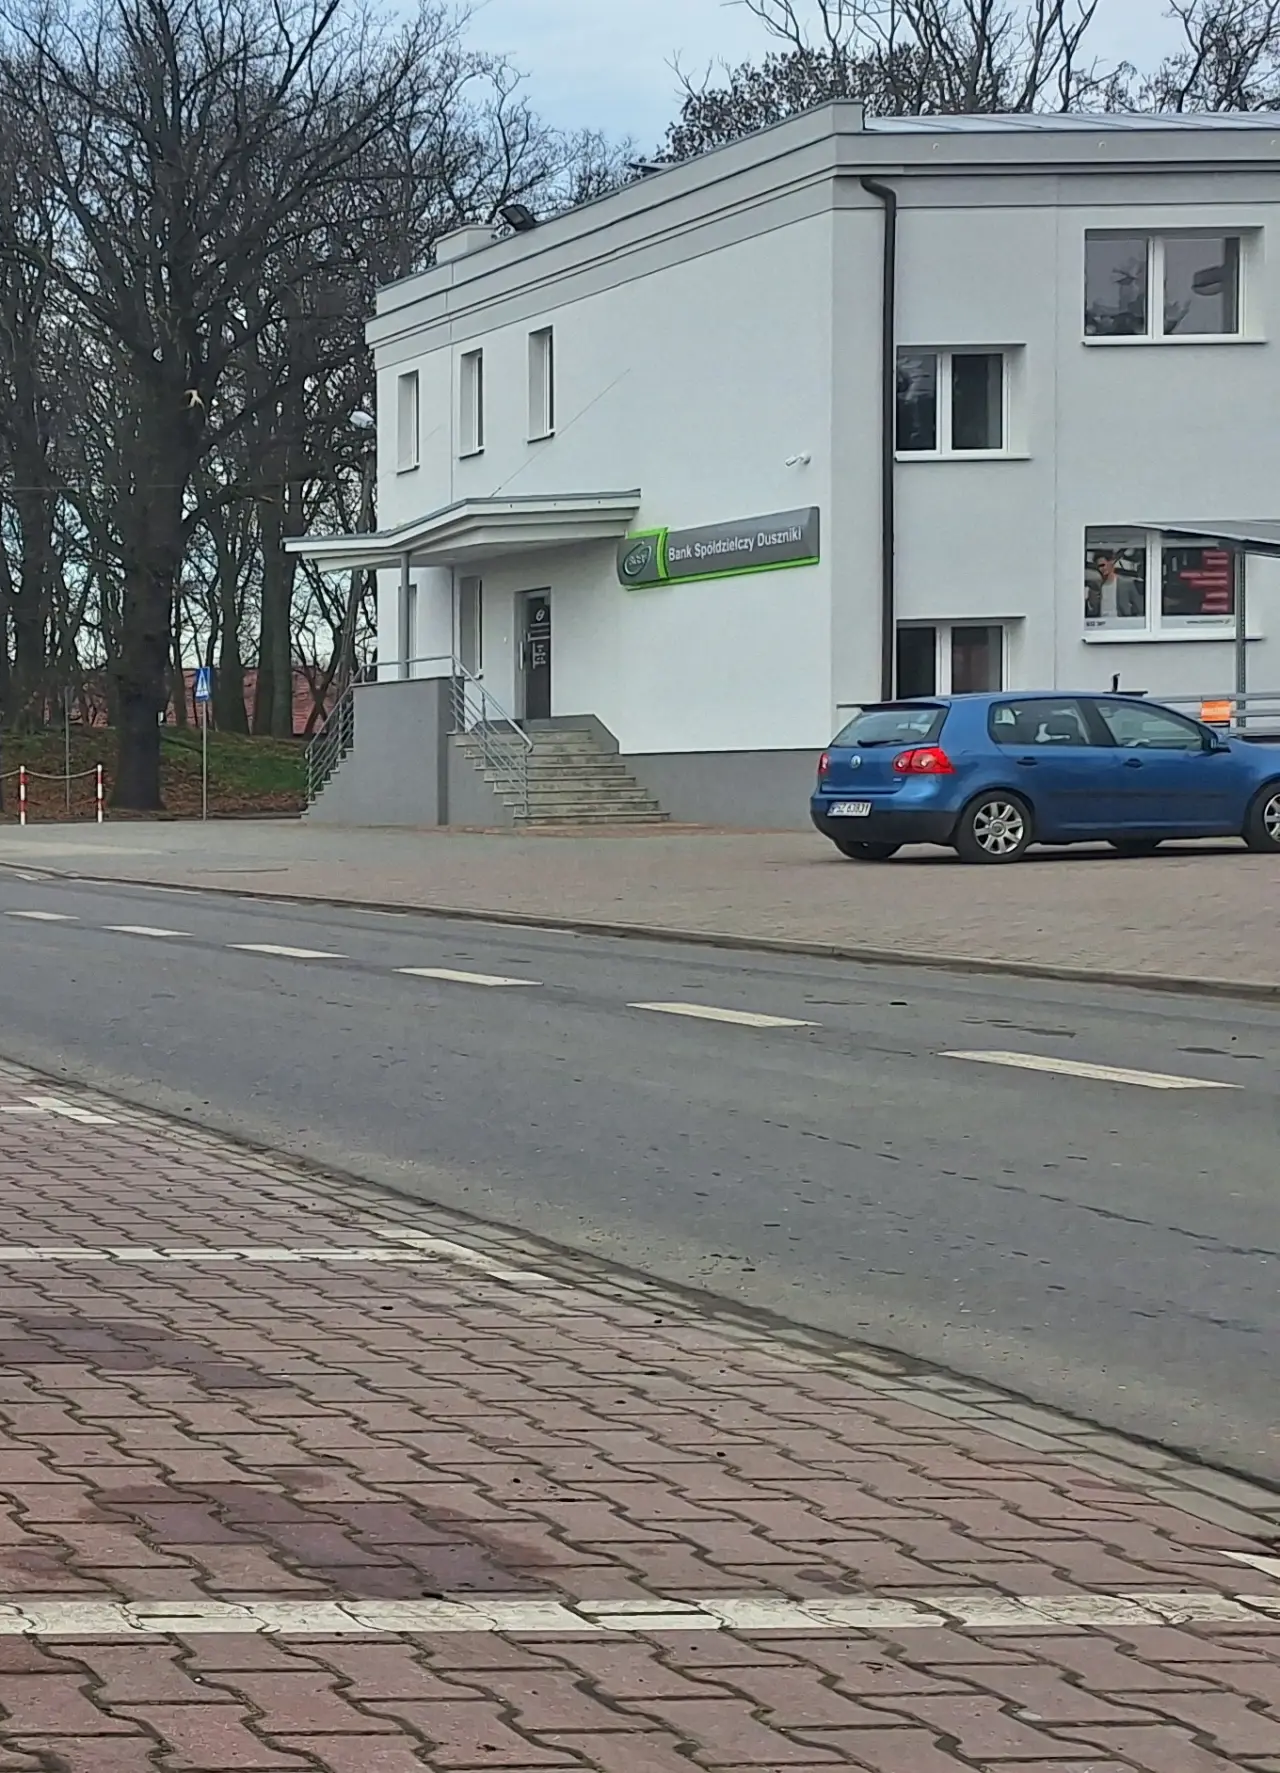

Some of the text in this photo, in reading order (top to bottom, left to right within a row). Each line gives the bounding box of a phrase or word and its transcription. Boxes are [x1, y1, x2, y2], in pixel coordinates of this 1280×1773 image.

[668, 543, 692, 562] Bank
[694, 536, 754, 560] Spółdzielczy
[757, 525, 802, 548] Duszniki
